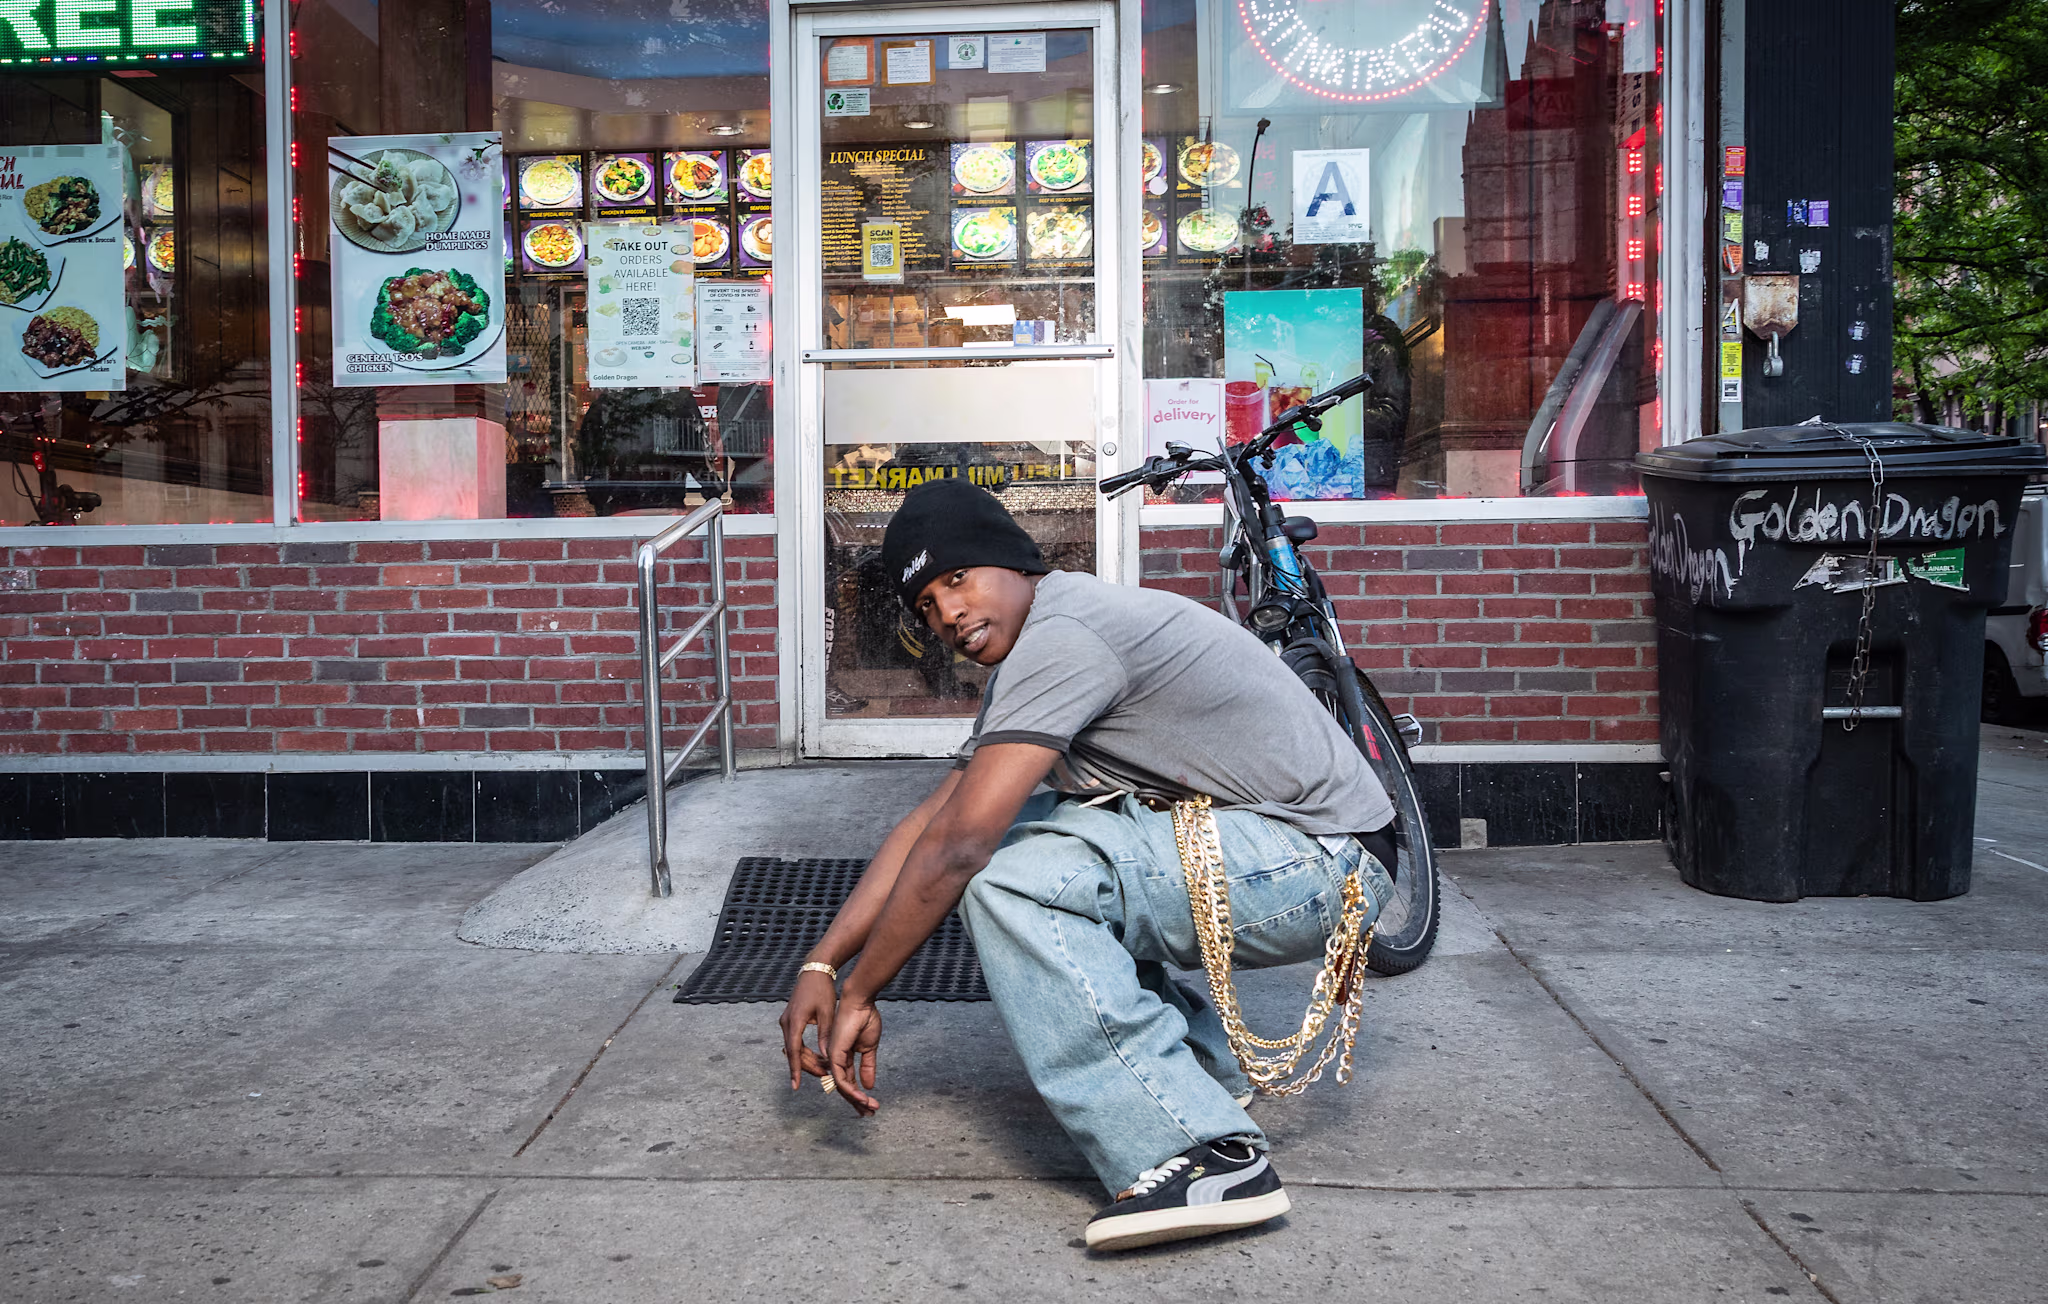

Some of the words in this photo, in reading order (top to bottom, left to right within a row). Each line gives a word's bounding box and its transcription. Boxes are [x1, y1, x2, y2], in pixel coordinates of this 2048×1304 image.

[829, 151, 874, 164] LUNCH
[875, 149, 925, 162] SPECIAL
[1305, 161, 1357, 218] A
[425, 232, 458, 241] HOME
[459, 231, 490, 240] MADE
[869, 229, 893, 237] SCAN
[425, 240, 488, 251] DUMPLINGS
[613, 241, 641, 251] TAKE
[644, 241, 668, 250] OUT
[619, 255, 662, 265] ORDERS
[613, 268, 668, 279] AVAILABLE
[625, 282, 656, 292] HERE!
[346, 353, 392, 363] GENERAL
[393, 352, 423, 363] TSO'S
[346, 364, 393, 373] CHICKEN
[1153, 407, 1216, 425] delivery
[1729, 486, 1868, 552] Golden
[1878, 492, 2008, 541] Dragon
[1912, 564, 1956, 572] SUSAINABL
